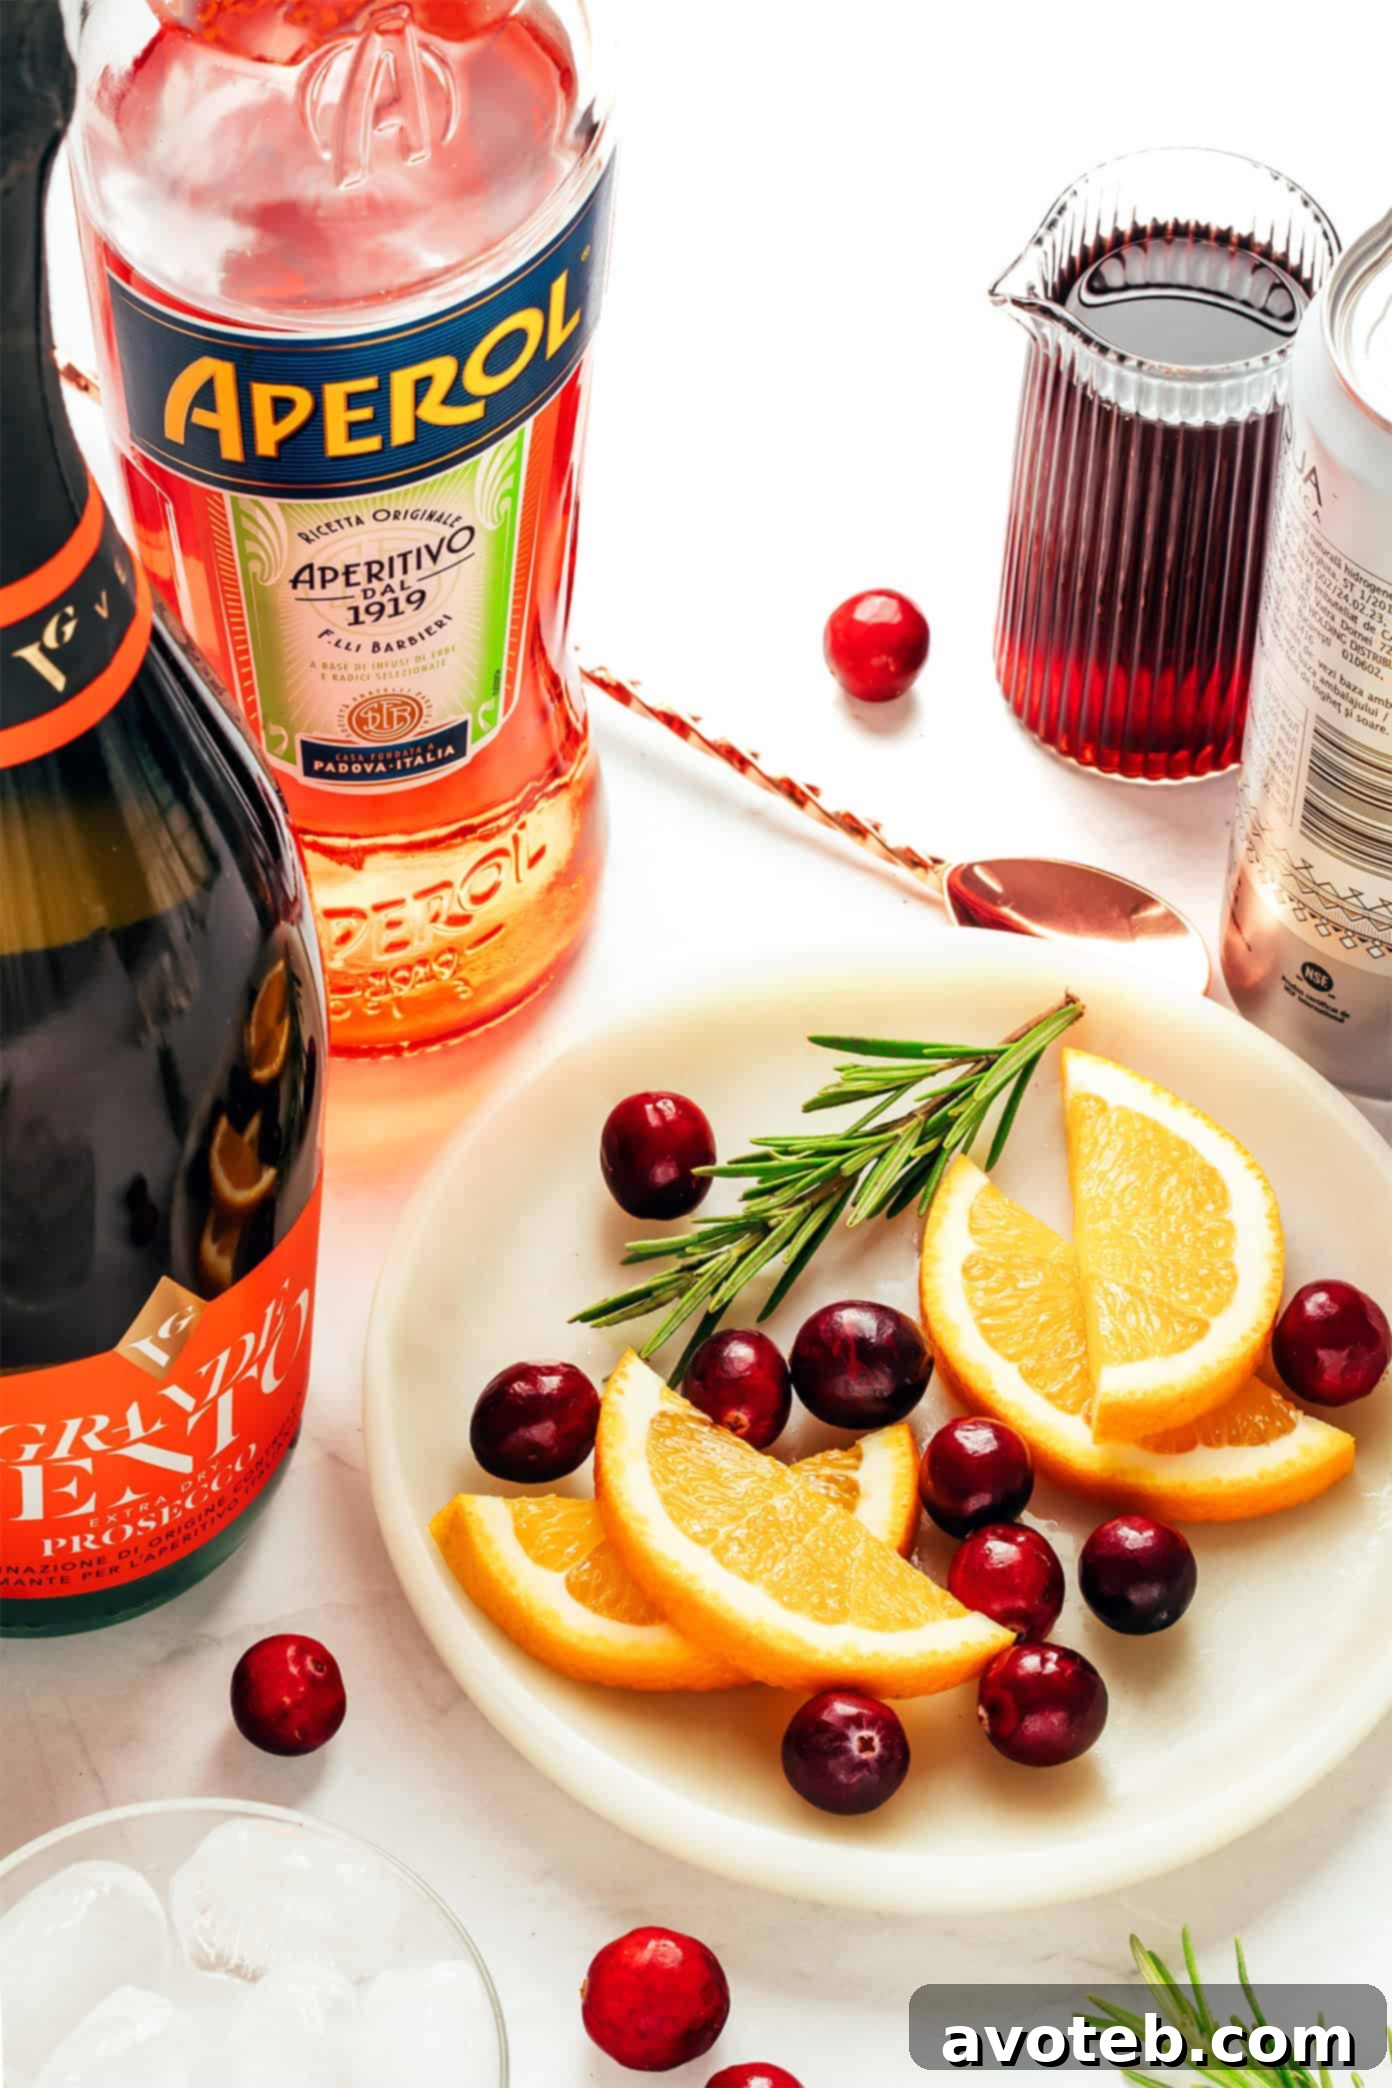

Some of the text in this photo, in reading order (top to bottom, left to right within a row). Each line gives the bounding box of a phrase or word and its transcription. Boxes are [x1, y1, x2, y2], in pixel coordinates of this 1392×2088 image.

[164, 269, 580, 463] APEROL
[297, 508, 463, 545] RICETTA ORIGINALE
[289, 525, 475, 590] APERITIVO
[361, 579, 412, 600] DAL
[1343, 577, 1356, 593] ST
[347, 589, 427, 627] 1919
[317, 613, 453, 654] F.LLI BARBIERI
[1341, 619, 1373, 646] Dornei
[1363, 621, 1376, 634] de
[310, 660, 316, 668] A
[321, 662, 348, 671] BASE
[354, 663, 366, 671] DI
[371, 658, 409, 670] INFUSI
[414, 654, 426, 663] DI
[332, 672, 371, 682] RADICI
[375, 658, 447, 681] SELEZIONATE
[1319, 676, 1379, 718] ambalajului
[1340, 674, 1364, 697] baza
[1356, 714, 1390, 737] soare.
[336, 753, 363, 761] CASA
[371, 748, 422, 760] FONDATA
[322, 821, 546, 967] PEROL
[42, 1443, 256, 1557] PROSECCO
[90, 1460, 219, 1528] EXTRA DRY
[82, 1565, 119, 1581] PER
[130, 1497, 239, 1569] L'APERITIVO
[118, 1546, 138, 1560] DI
[148, 1495, 225, 1548] ORIGINE
